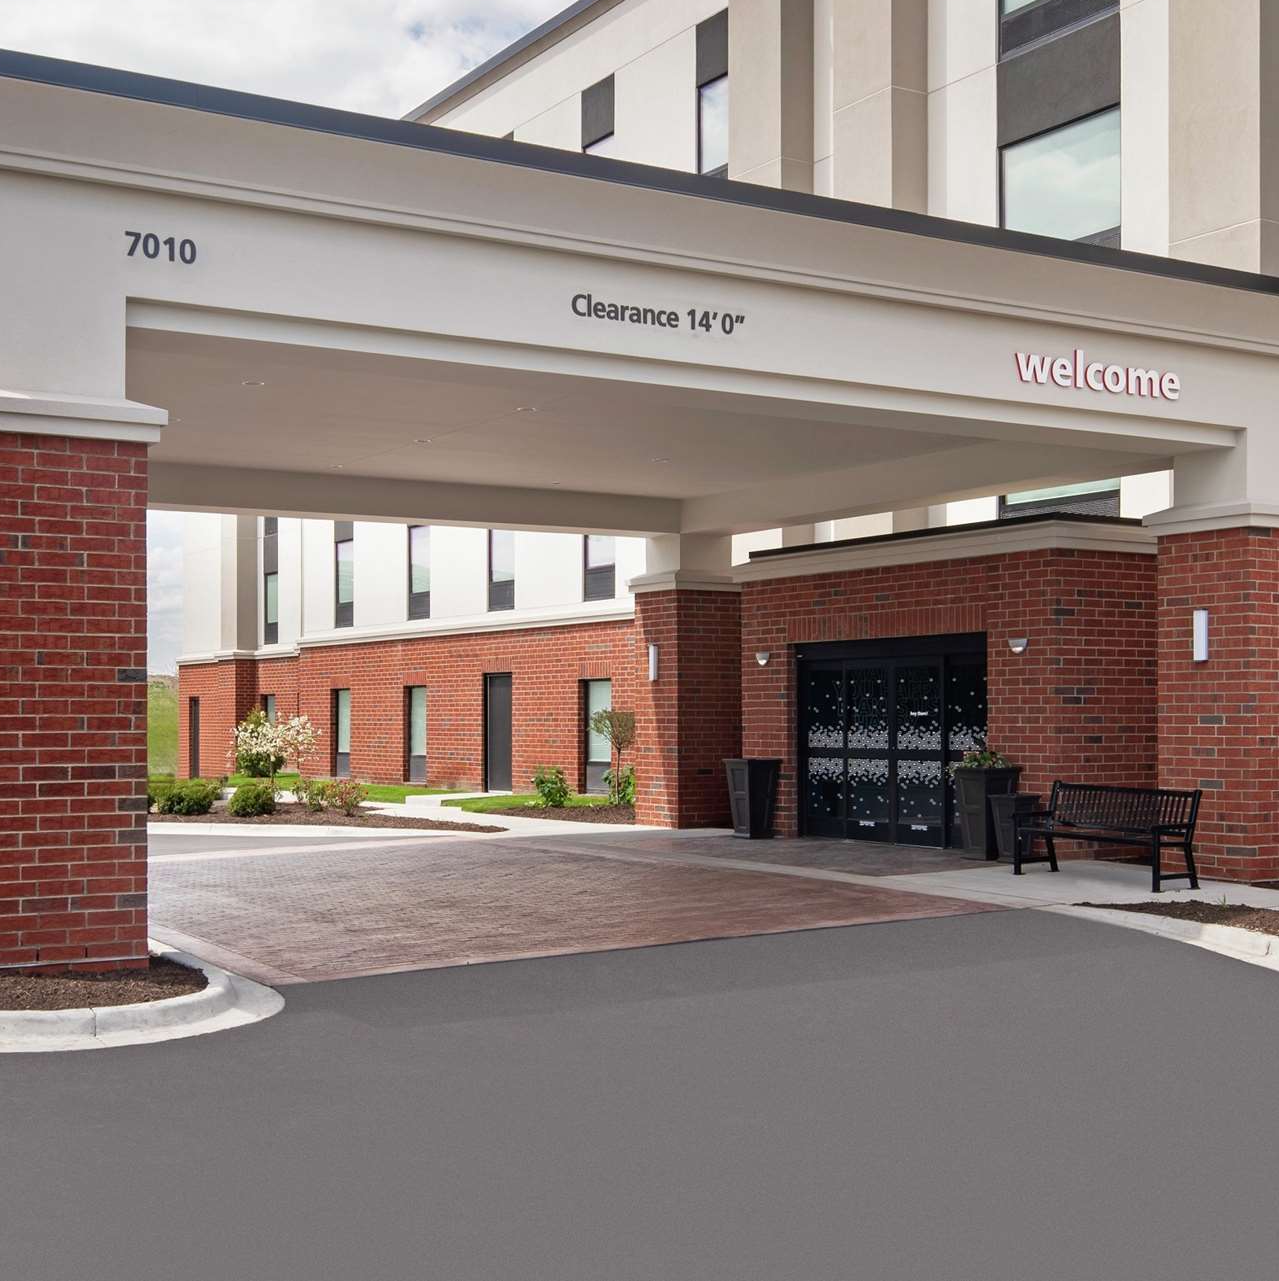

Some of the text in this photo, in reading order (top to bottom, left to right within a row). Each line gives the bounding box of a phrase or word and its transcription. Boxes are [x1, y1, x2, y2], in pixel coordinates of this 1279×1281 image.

[124, 230, 197, 265] 7010
[571, 293, 680, 329] Clearance
[1014, 349, 1181, 400] welcome
